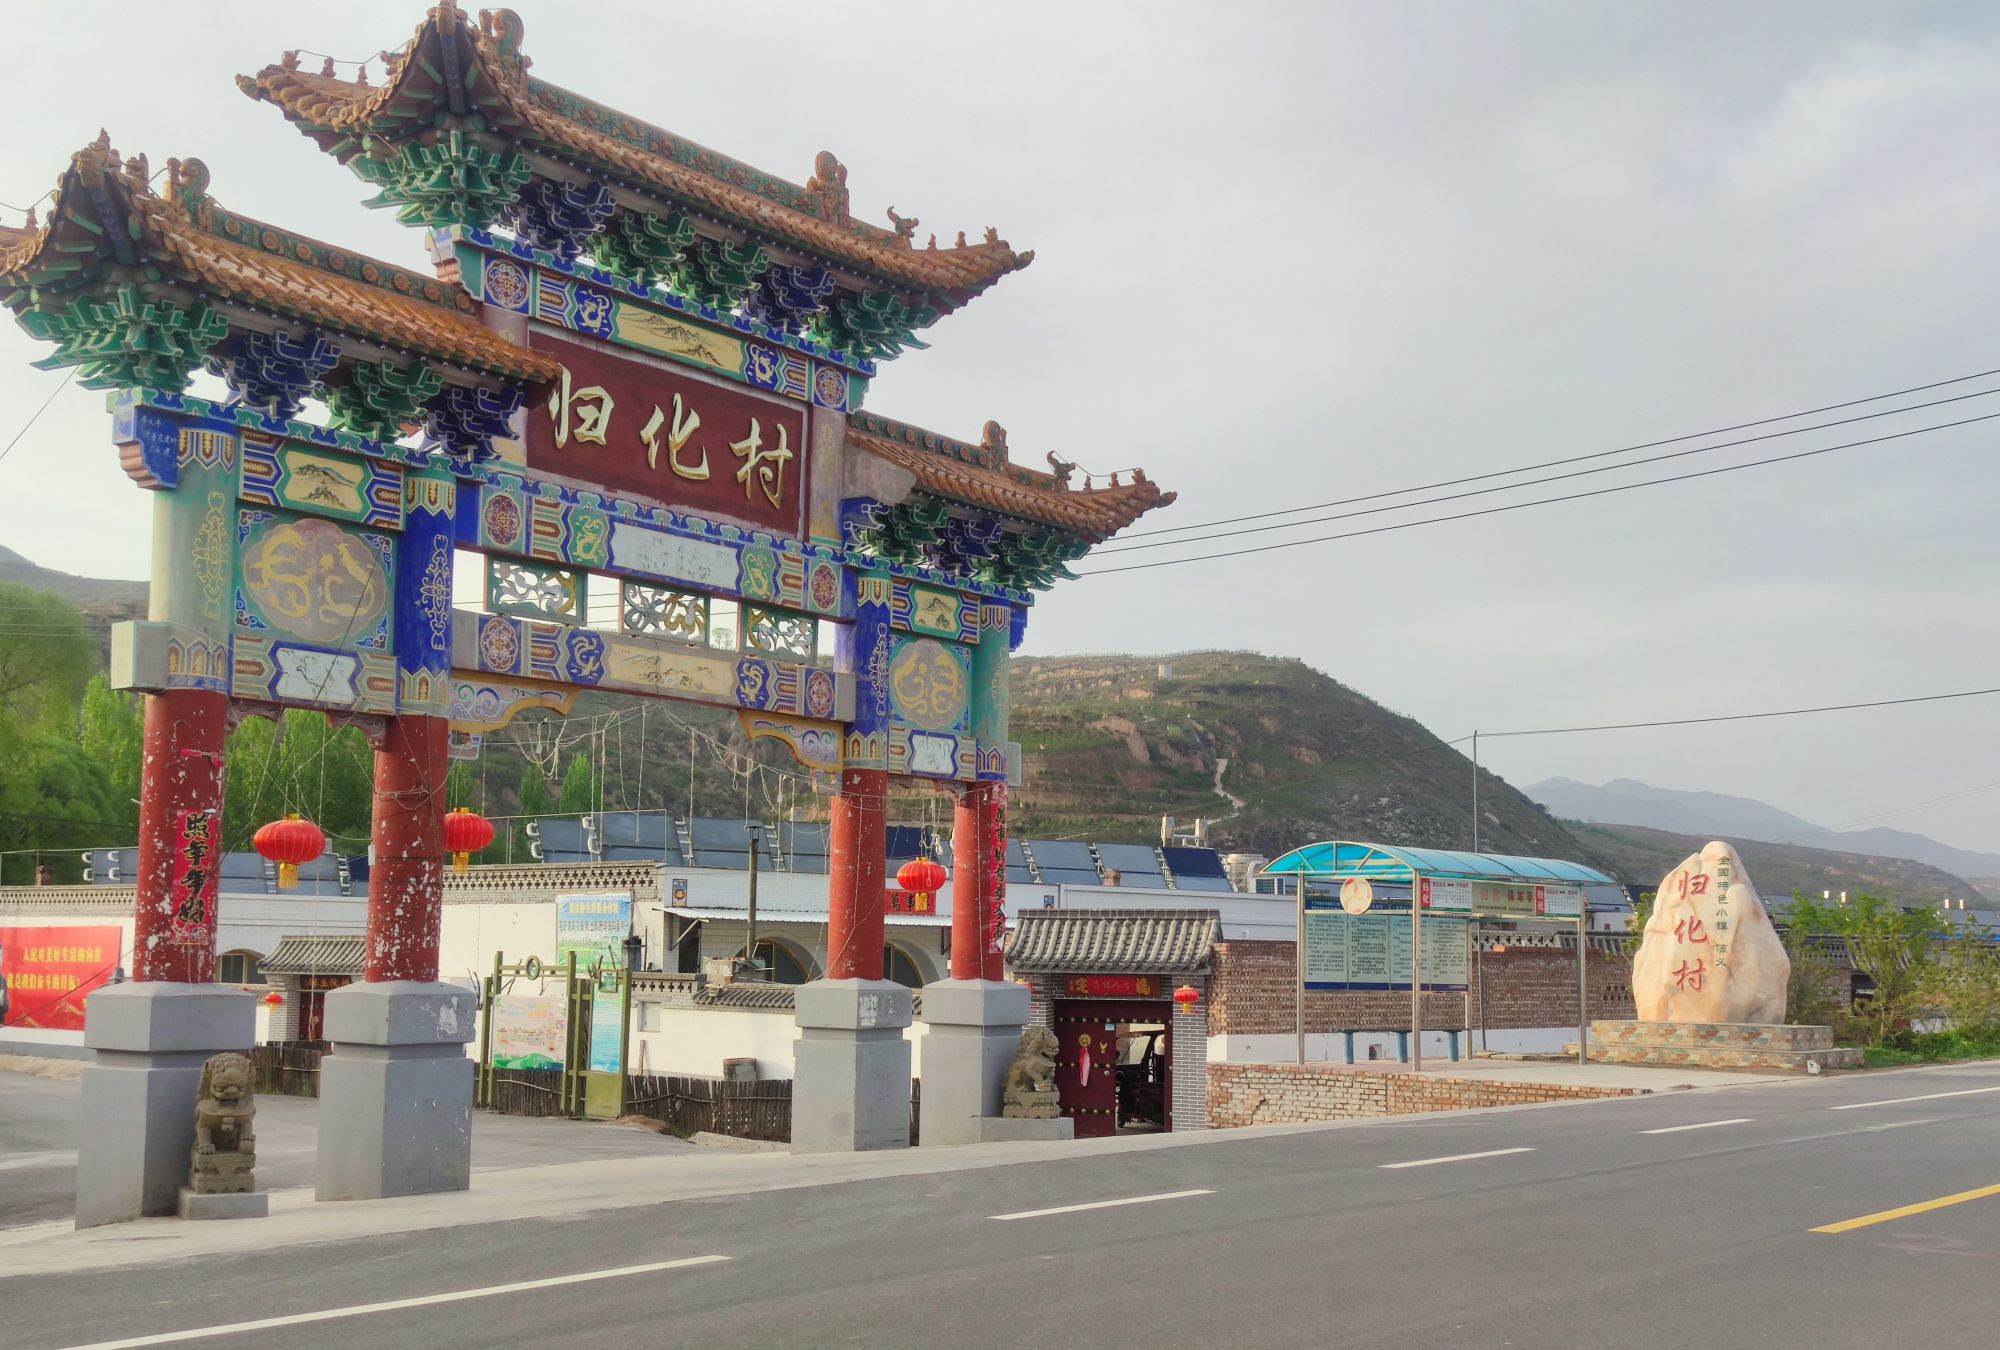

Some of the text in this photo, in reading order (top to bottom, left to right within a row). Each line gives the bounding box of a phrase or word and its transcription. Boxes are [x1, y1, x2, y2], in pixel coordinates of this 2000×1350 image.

[548, 363, 794, 510] 归化村
[890, 893, 931, 912] 萬事
[1672, 870, 1710, 993] 归化村
[23, 946, 102, 963] 人民对美好生活的向往
